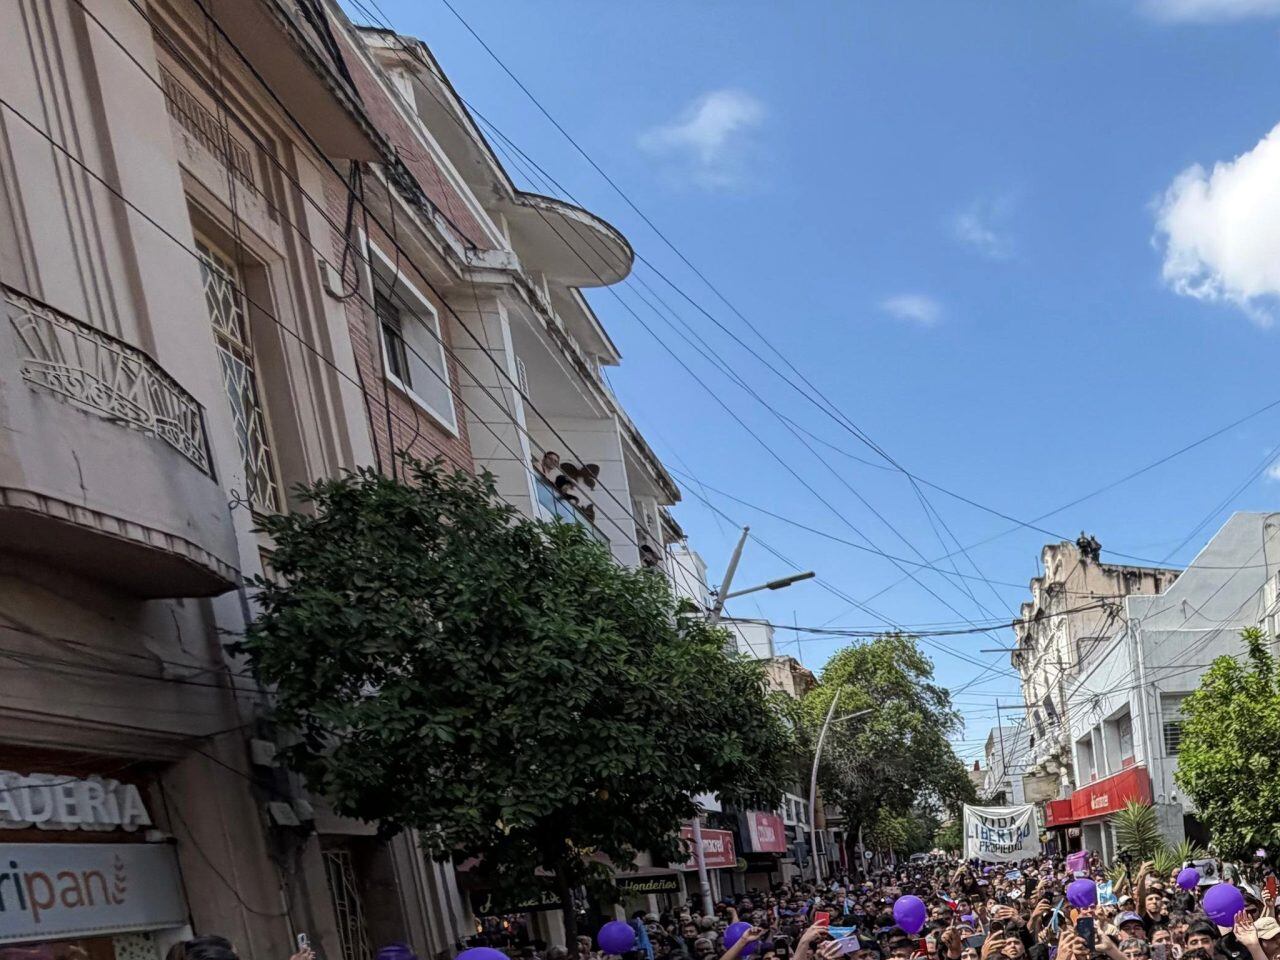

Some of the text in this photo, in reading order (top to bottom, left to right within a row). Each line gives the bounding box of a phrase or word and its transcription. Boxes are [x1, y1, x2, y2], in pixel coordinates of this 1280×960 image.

[981, 816, 1016, 828] VIDA
[968, 823, 1031, 843] LIBERTAD
[979, 840, 1023, 854] PROPIEDAD
